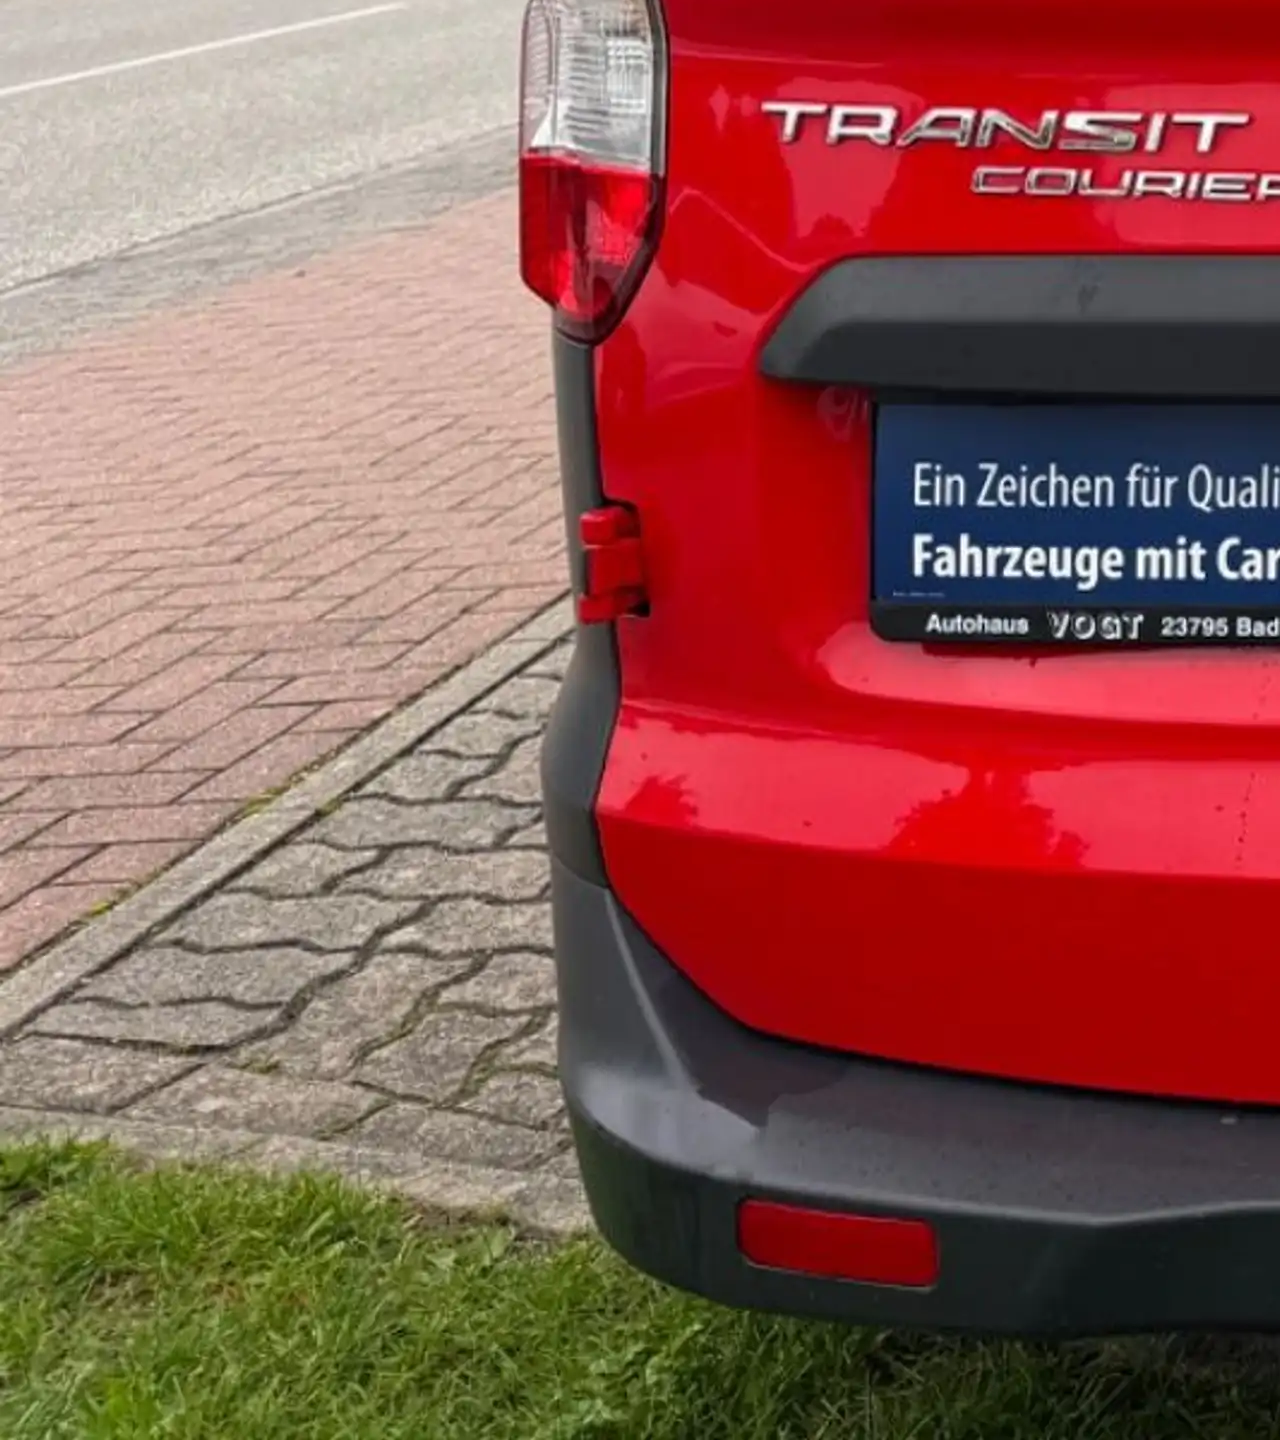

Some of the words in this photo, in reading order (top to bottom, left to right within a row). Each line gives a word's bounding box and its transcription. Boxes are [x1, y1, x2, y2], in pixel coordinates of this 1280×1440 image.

[761, 101, 1250, 152] TRANSIT
[913, 462, 966, 508] Ein
[975, 462, 1116, 508] Zeichen
[1124, 462, 1180, 509] für
[912, 532, 1126, 592] Fahrzeuge
[1136, 535, 1208, 582] mit
[925, 613, 1030, 636] Autohaus
[1048, 611, 1145, 641] VOGT
[1160, 616, 1230, 638] 23795
